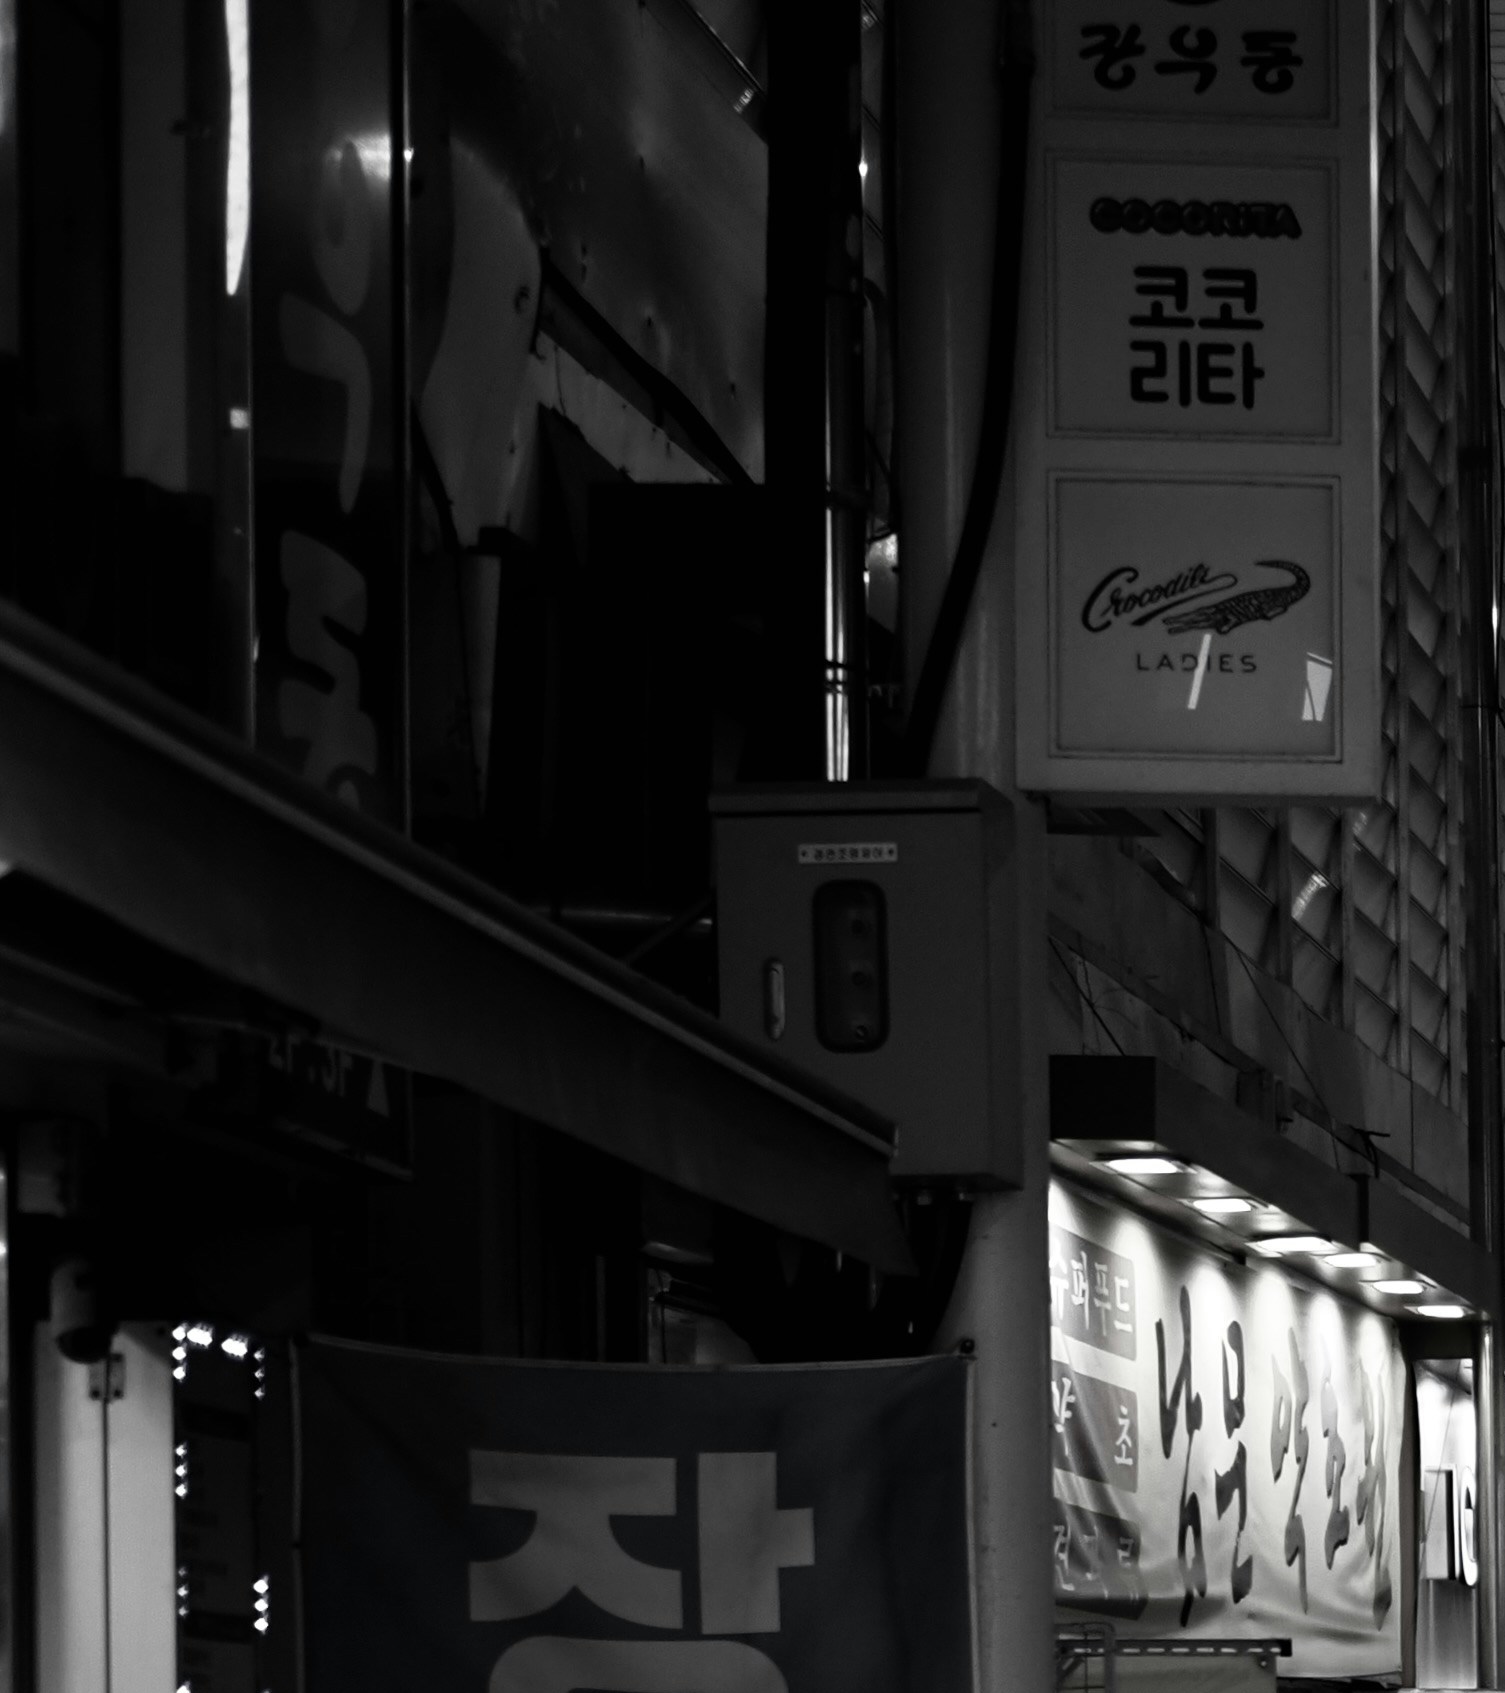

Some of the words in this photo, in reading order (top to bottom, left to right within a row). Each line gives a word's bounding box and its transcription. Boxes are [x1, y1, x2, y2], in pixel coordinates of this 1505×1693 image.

[1129, 266, 1264, 330] 코코
[1129, 340, 1265, 410] 리타
[1136, 653, 1257, 674] LADIES
